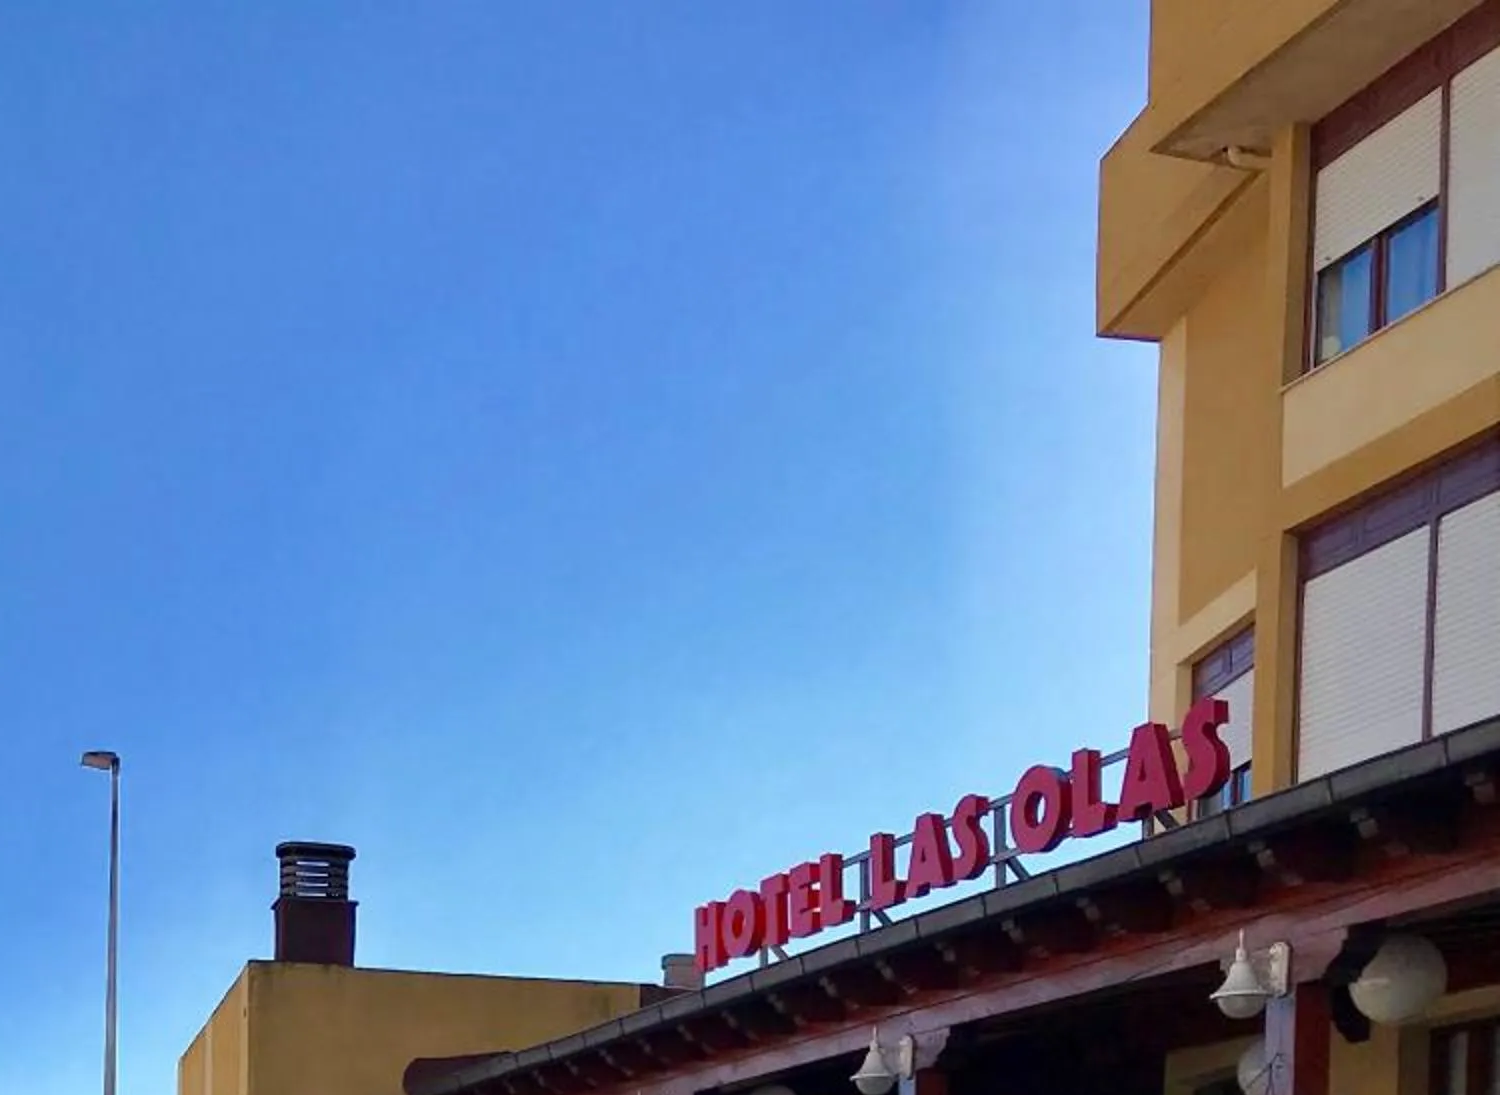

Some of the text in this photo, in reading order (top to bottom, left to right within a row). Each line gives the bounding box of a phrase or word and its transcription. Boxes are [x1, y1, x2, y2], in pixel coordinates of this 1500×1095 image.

[694, 697, 1230, 972] HOTEL LAS OLAS
